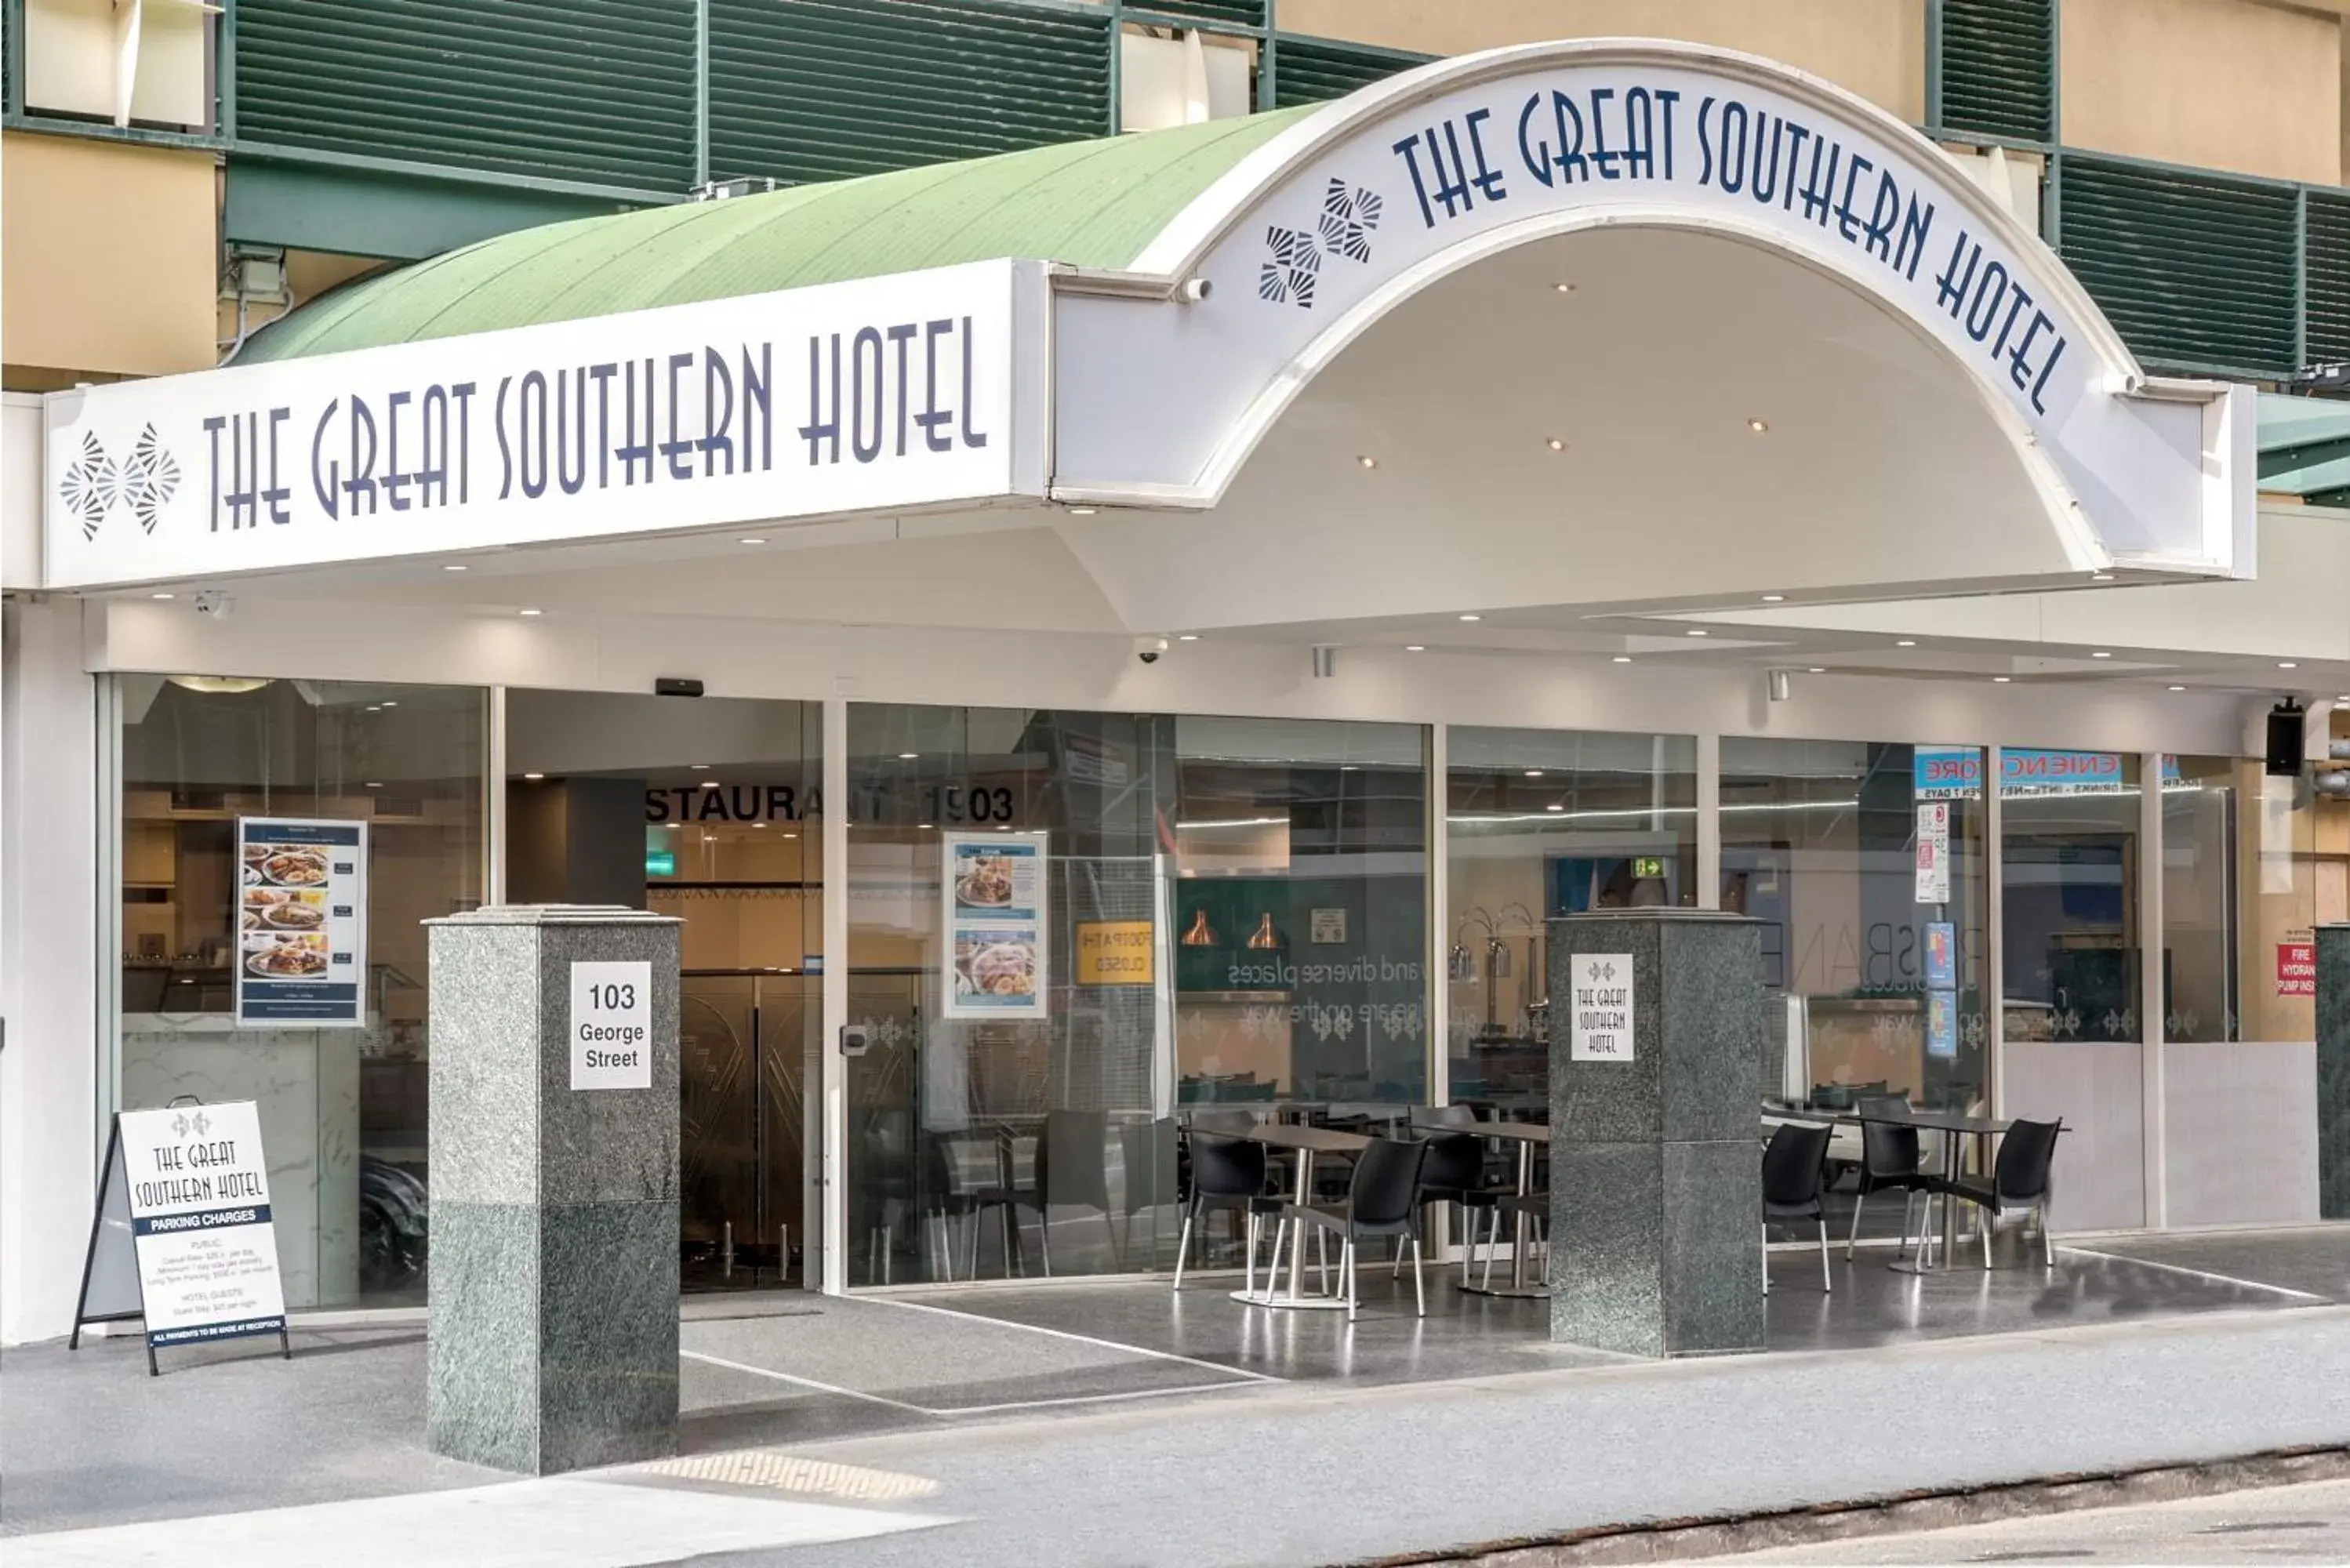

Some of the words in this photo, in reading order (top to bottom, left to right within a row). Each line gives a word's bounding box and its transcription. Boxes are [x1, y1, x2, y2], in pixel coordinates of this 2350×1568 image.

[1393, 107, 1506, 228] THE
[1518, 86, 1680, 188] GREAT
[1698, 96, 1934, 281] SOUTHERN
[1936, 230, 2066, 416] HOTEL
[203, 407, 290, 532] THE
[311, 382, 476, 522] GREAT
[496, 342, 772, 499] SOUTHERN
[797, 316, 986, 466] HOTEL
[2292, 949, 2310, 961] FIRE
[590, 984, 635, 1010] 103
[1577, 989, 1593, 1007] THE
[1597, 989, 1626, 1007] GREAT
[1580, 1011, 1625, 1030] SOUTHERN
[579, 1023, 644, 1045] George
[1589, 1034, 1617, 1054] HOTEL
[586, 1049, 638, 1068] Street
[153, 1146, 183, 1171] THE
[187, 1141, 235, 1167] GREAT
[136, 1177, 212, 1207] SOUTHERN
[218, 1172, 263, 1199] HOTEL
[151, 1216, 201, 1232] PARKING
[202, 1210, 256, 1225] CHARGES
